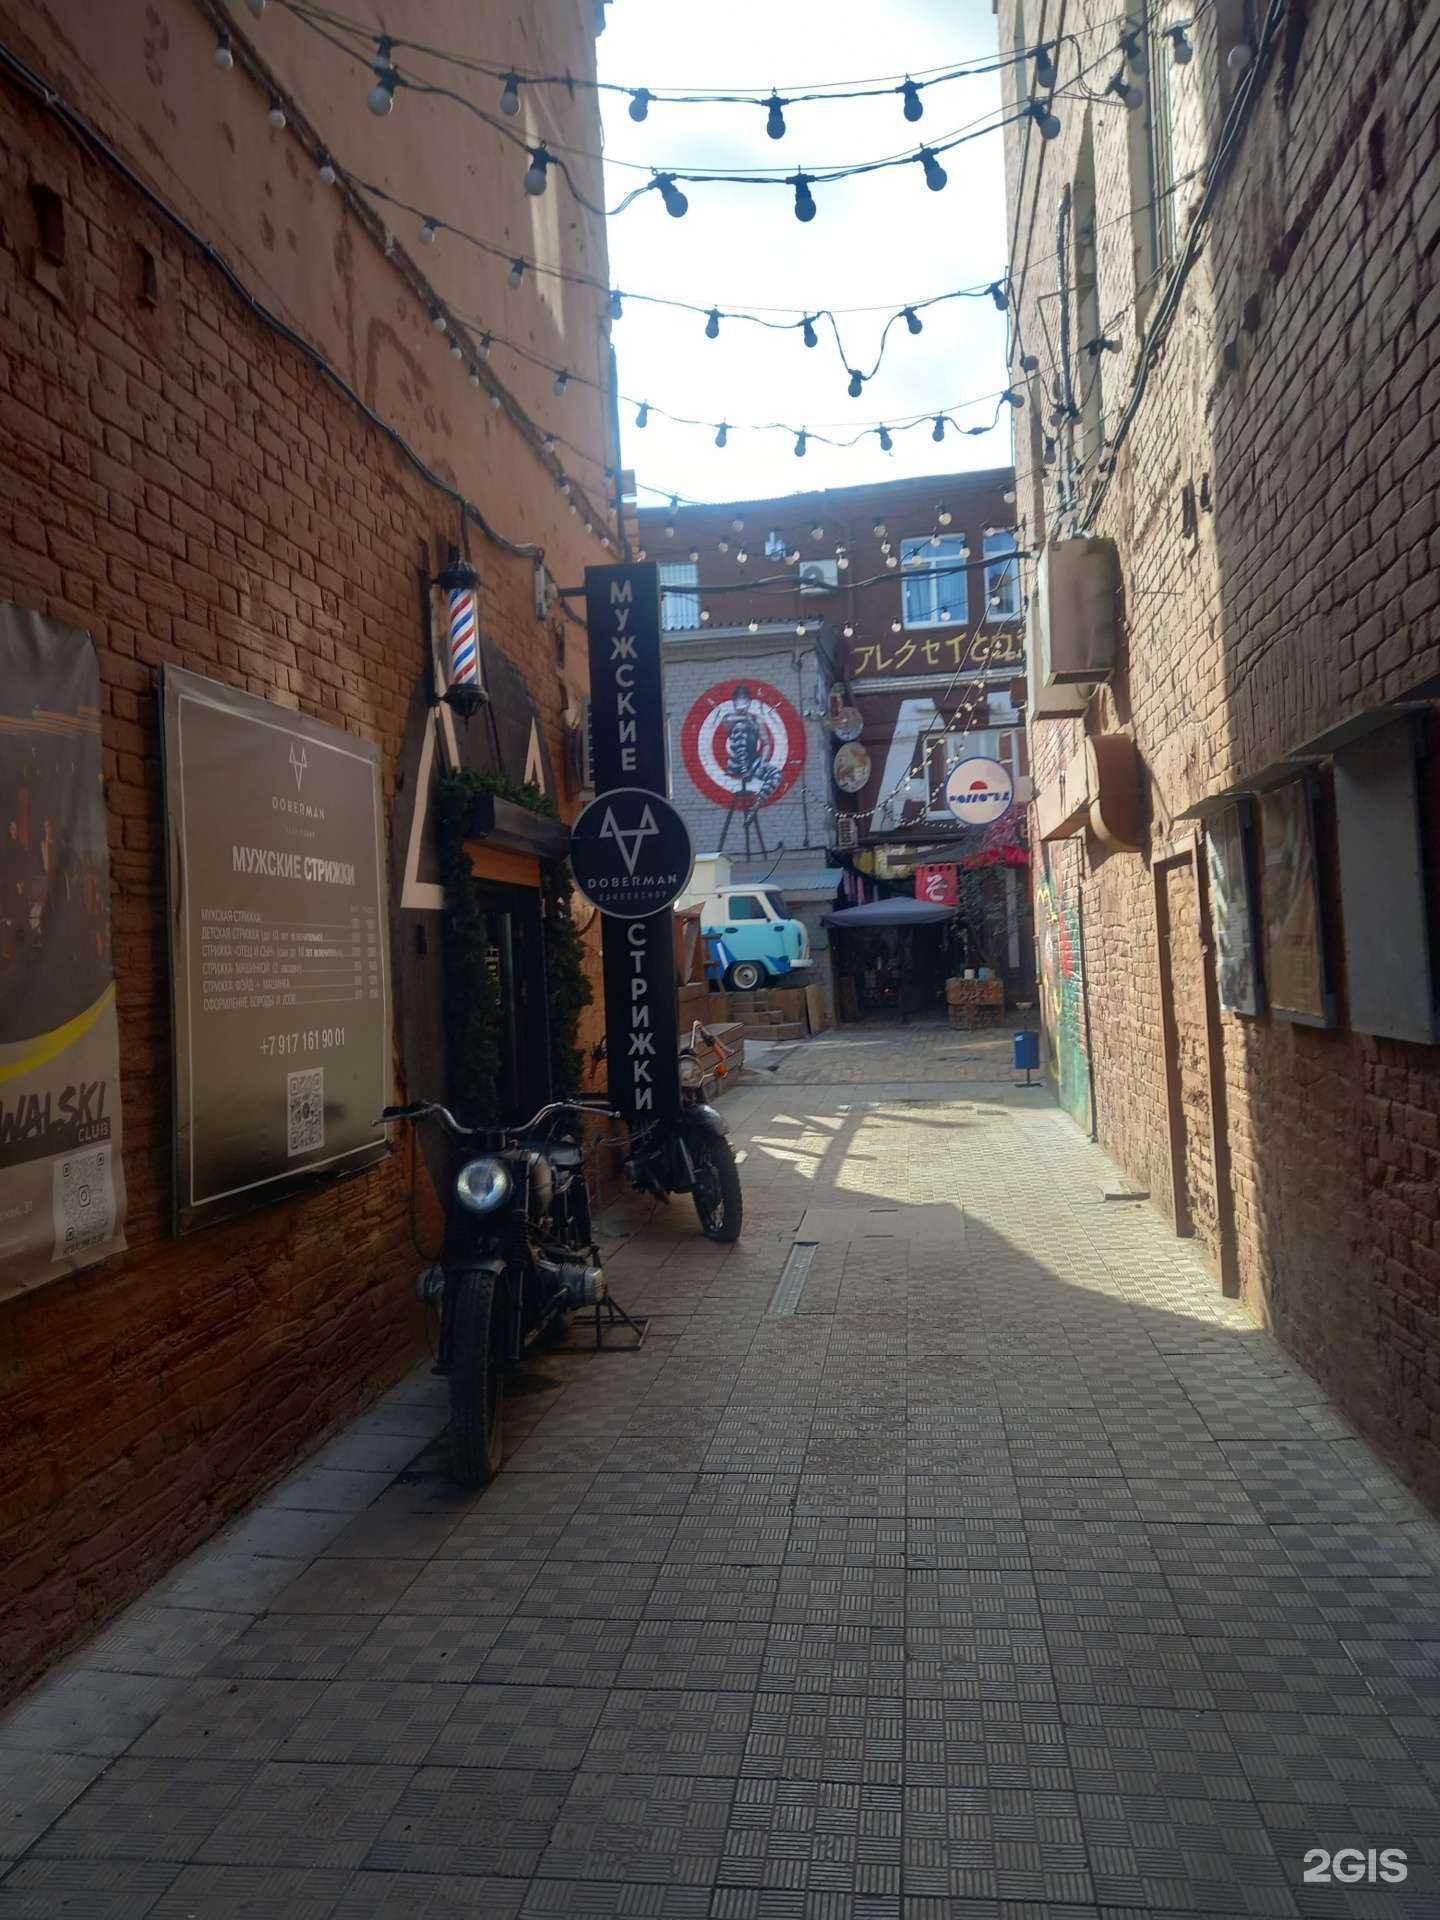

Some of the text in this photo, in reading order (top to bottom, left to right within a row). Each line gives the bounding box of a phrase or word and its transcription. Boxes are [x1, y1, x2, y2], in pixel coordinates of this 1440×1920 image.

[609, 579, 639, 771] МУЖСКИЕ
[271, 795, 325, 820] DOBERMAN
[232, 845, 355, 886] МУЖСКИЕ СТРИЖКИ
[588, 874, 677, 889] DOBERMAN
[627, 923, 656, 1110] СТРИЖКИ
[260, 1026, 345, 1056] +7 917 161 90 01
[78, 1122, 109, 1142] CLUB
